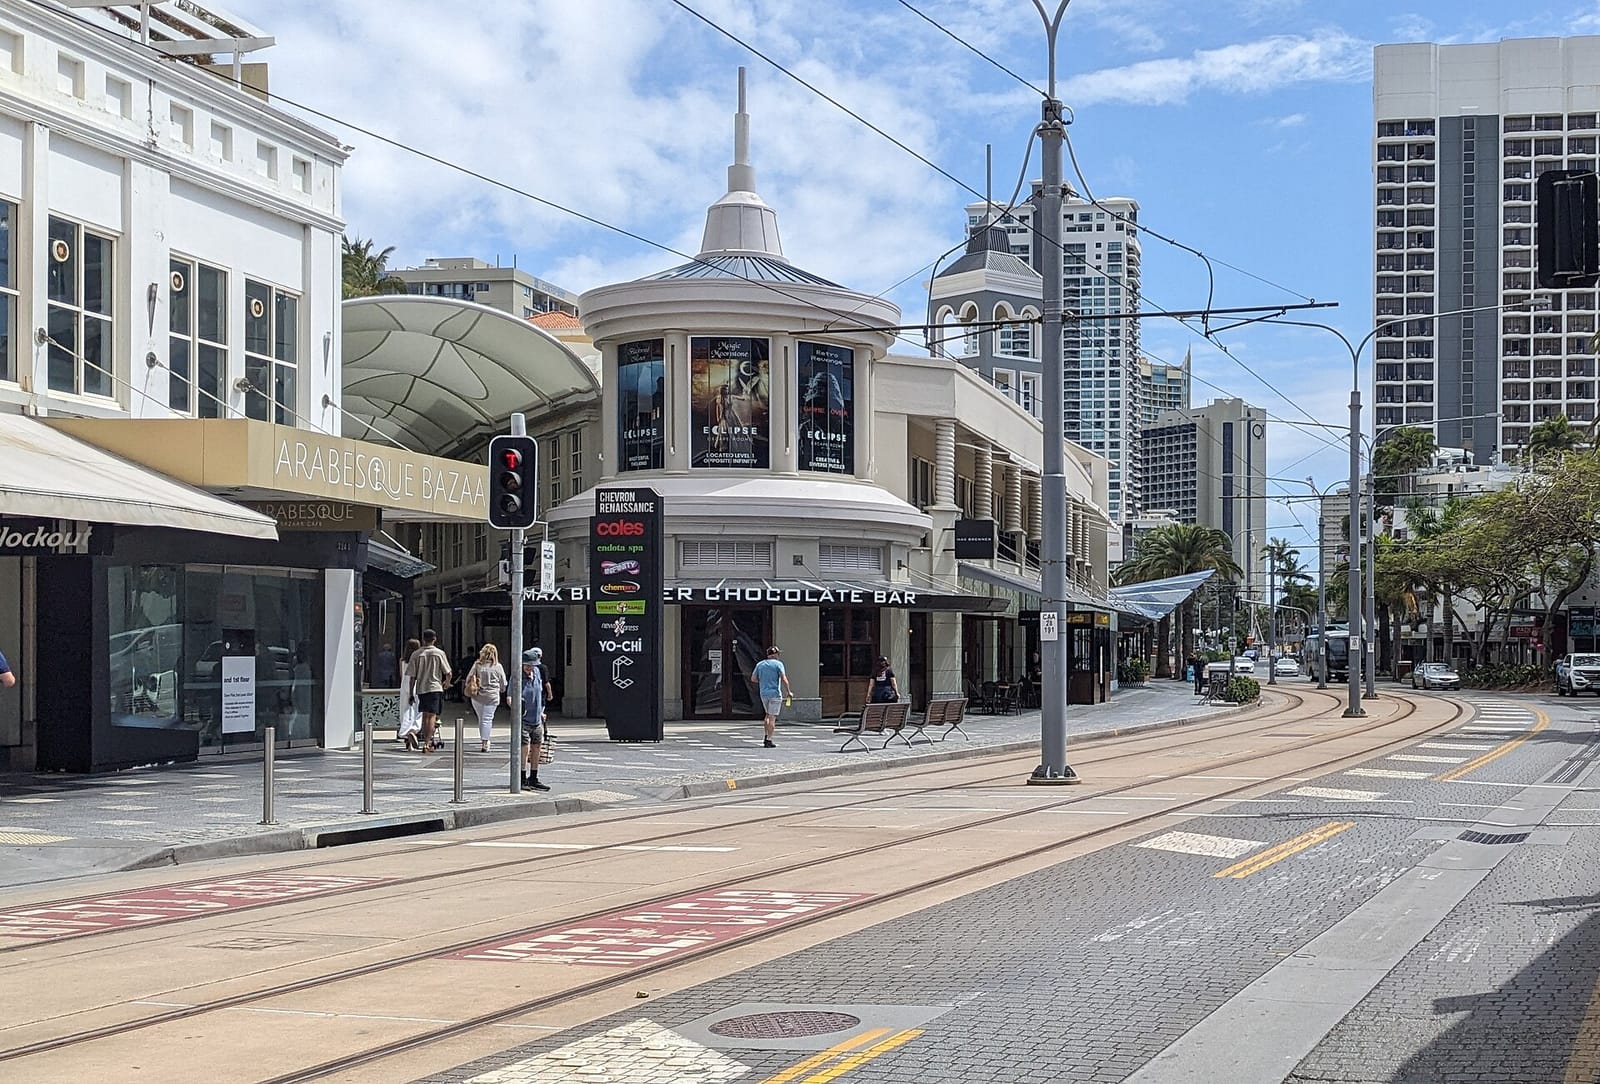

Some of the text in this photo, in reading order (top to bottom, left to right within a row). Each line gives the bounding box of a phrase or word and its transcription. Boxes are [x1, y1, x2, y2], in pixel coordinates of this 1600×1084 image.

[275, 440, 486, 506] ARABESQUE BAZAA
[600, 492, 636, 502] CHEVRON
[600, 502, 655, 513] RENAISSANCE
[597, 519, 644, 535] coles
[0, 525, 93, 548] lockout
[597, 543, 644, 554] endota spa
[705, 587, 864, 603] CHOCOLATE
[874, 590, 917, 604] BAR
